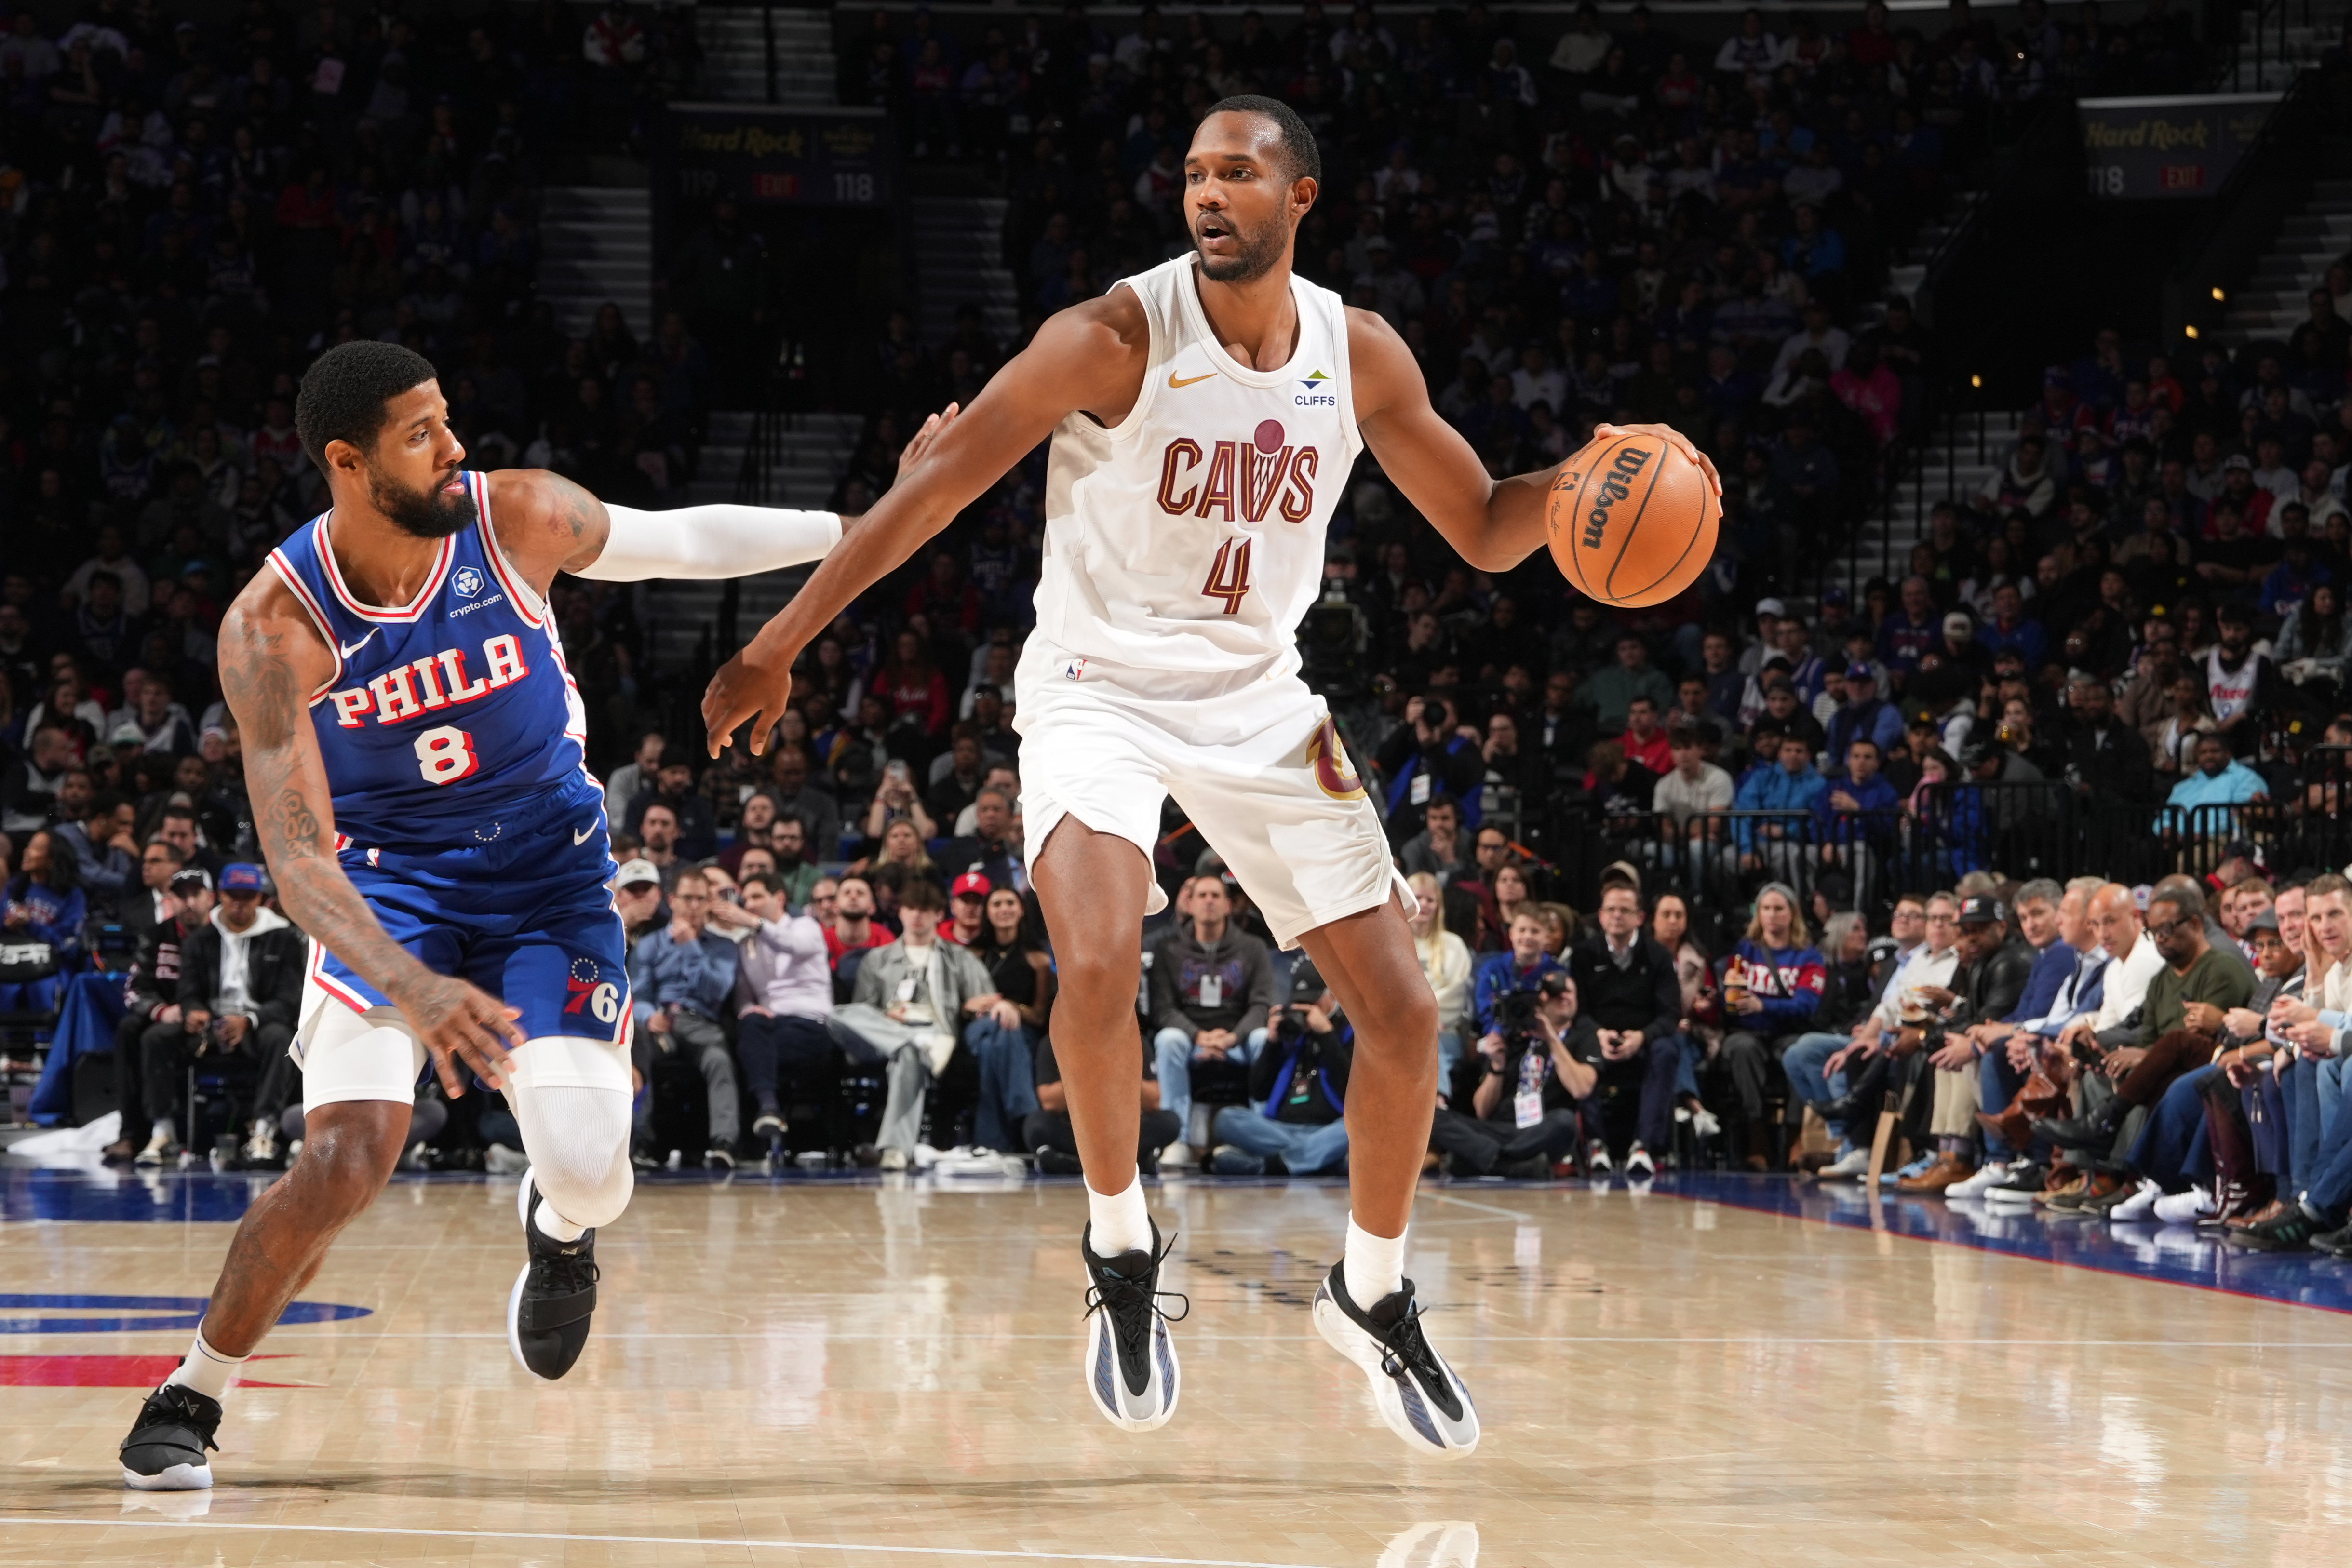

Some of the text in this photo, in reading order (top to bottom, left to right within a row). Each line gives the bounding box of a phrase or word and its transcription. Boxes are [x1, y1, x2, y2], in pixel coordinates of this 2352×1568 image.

[679, 123, 743, 152] Hard
[745, 125, 804, 158] Rock
[2085, 120, 2148, 148] Hard
[2150, 119, 2209, 151] Rock
[834, 172, 874, 201] 118
[2168, 165, 2199, 189] EXIT
[1295, 395, 1335, 406] CLIFFS
[1157, 437, 1319, 523] CAVS
[1582, 447, 1653, 549] Wilson
[1201, 536, 1251, 615] 4
[450, 594, 502, 618] crypto.com
[329, 634, 529, 728] PHILA
[414, 725, 479, 785] 8
[564, 975, 618, 1023] 76
